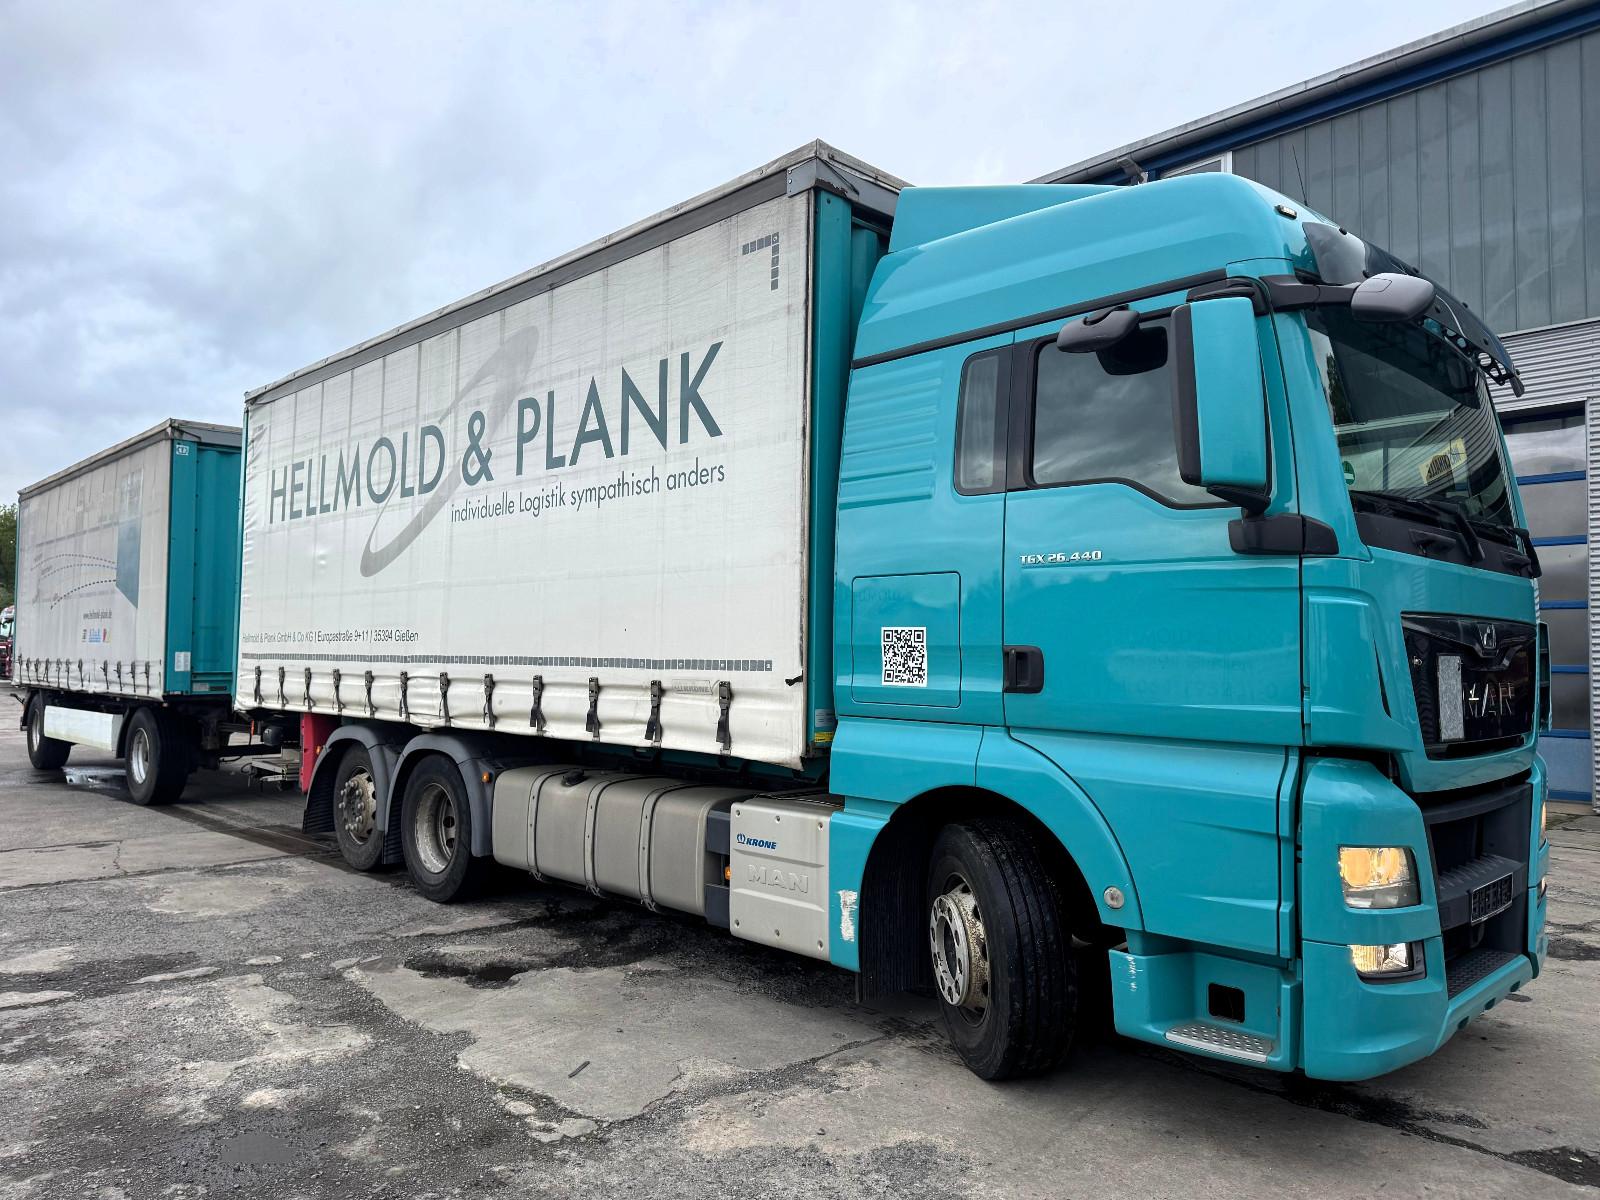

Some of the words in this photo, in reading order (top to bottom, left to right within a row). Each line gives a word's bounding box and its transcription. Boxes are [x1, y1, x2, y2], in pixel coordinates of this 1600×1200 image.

[270, 425, 445, 524] HELLMOLD
[462, 411, 494, 486] &
[516, 341, 724, 476] PLANK
[451, 493, 515, 523] individuelle
[519, 482, 566, 518] Logistik
[570, 466, 660, 512] sympathisch
[666, 457, 725, 490] anders
[1020, 554, 1046, 565] TGX
[1048, 550, 1103, 564] 26.440
[305, 631, 313, 642] KG
[317, 630, 353, 644] Europastraße
[354, 629, 369, 642] 9+11
[373, 629, 393, 642] 35394
[394, 629, 419, 642] Gießen
[746, 837, 777, 850] KRONE
[747, 864, 809, 894] MAN
